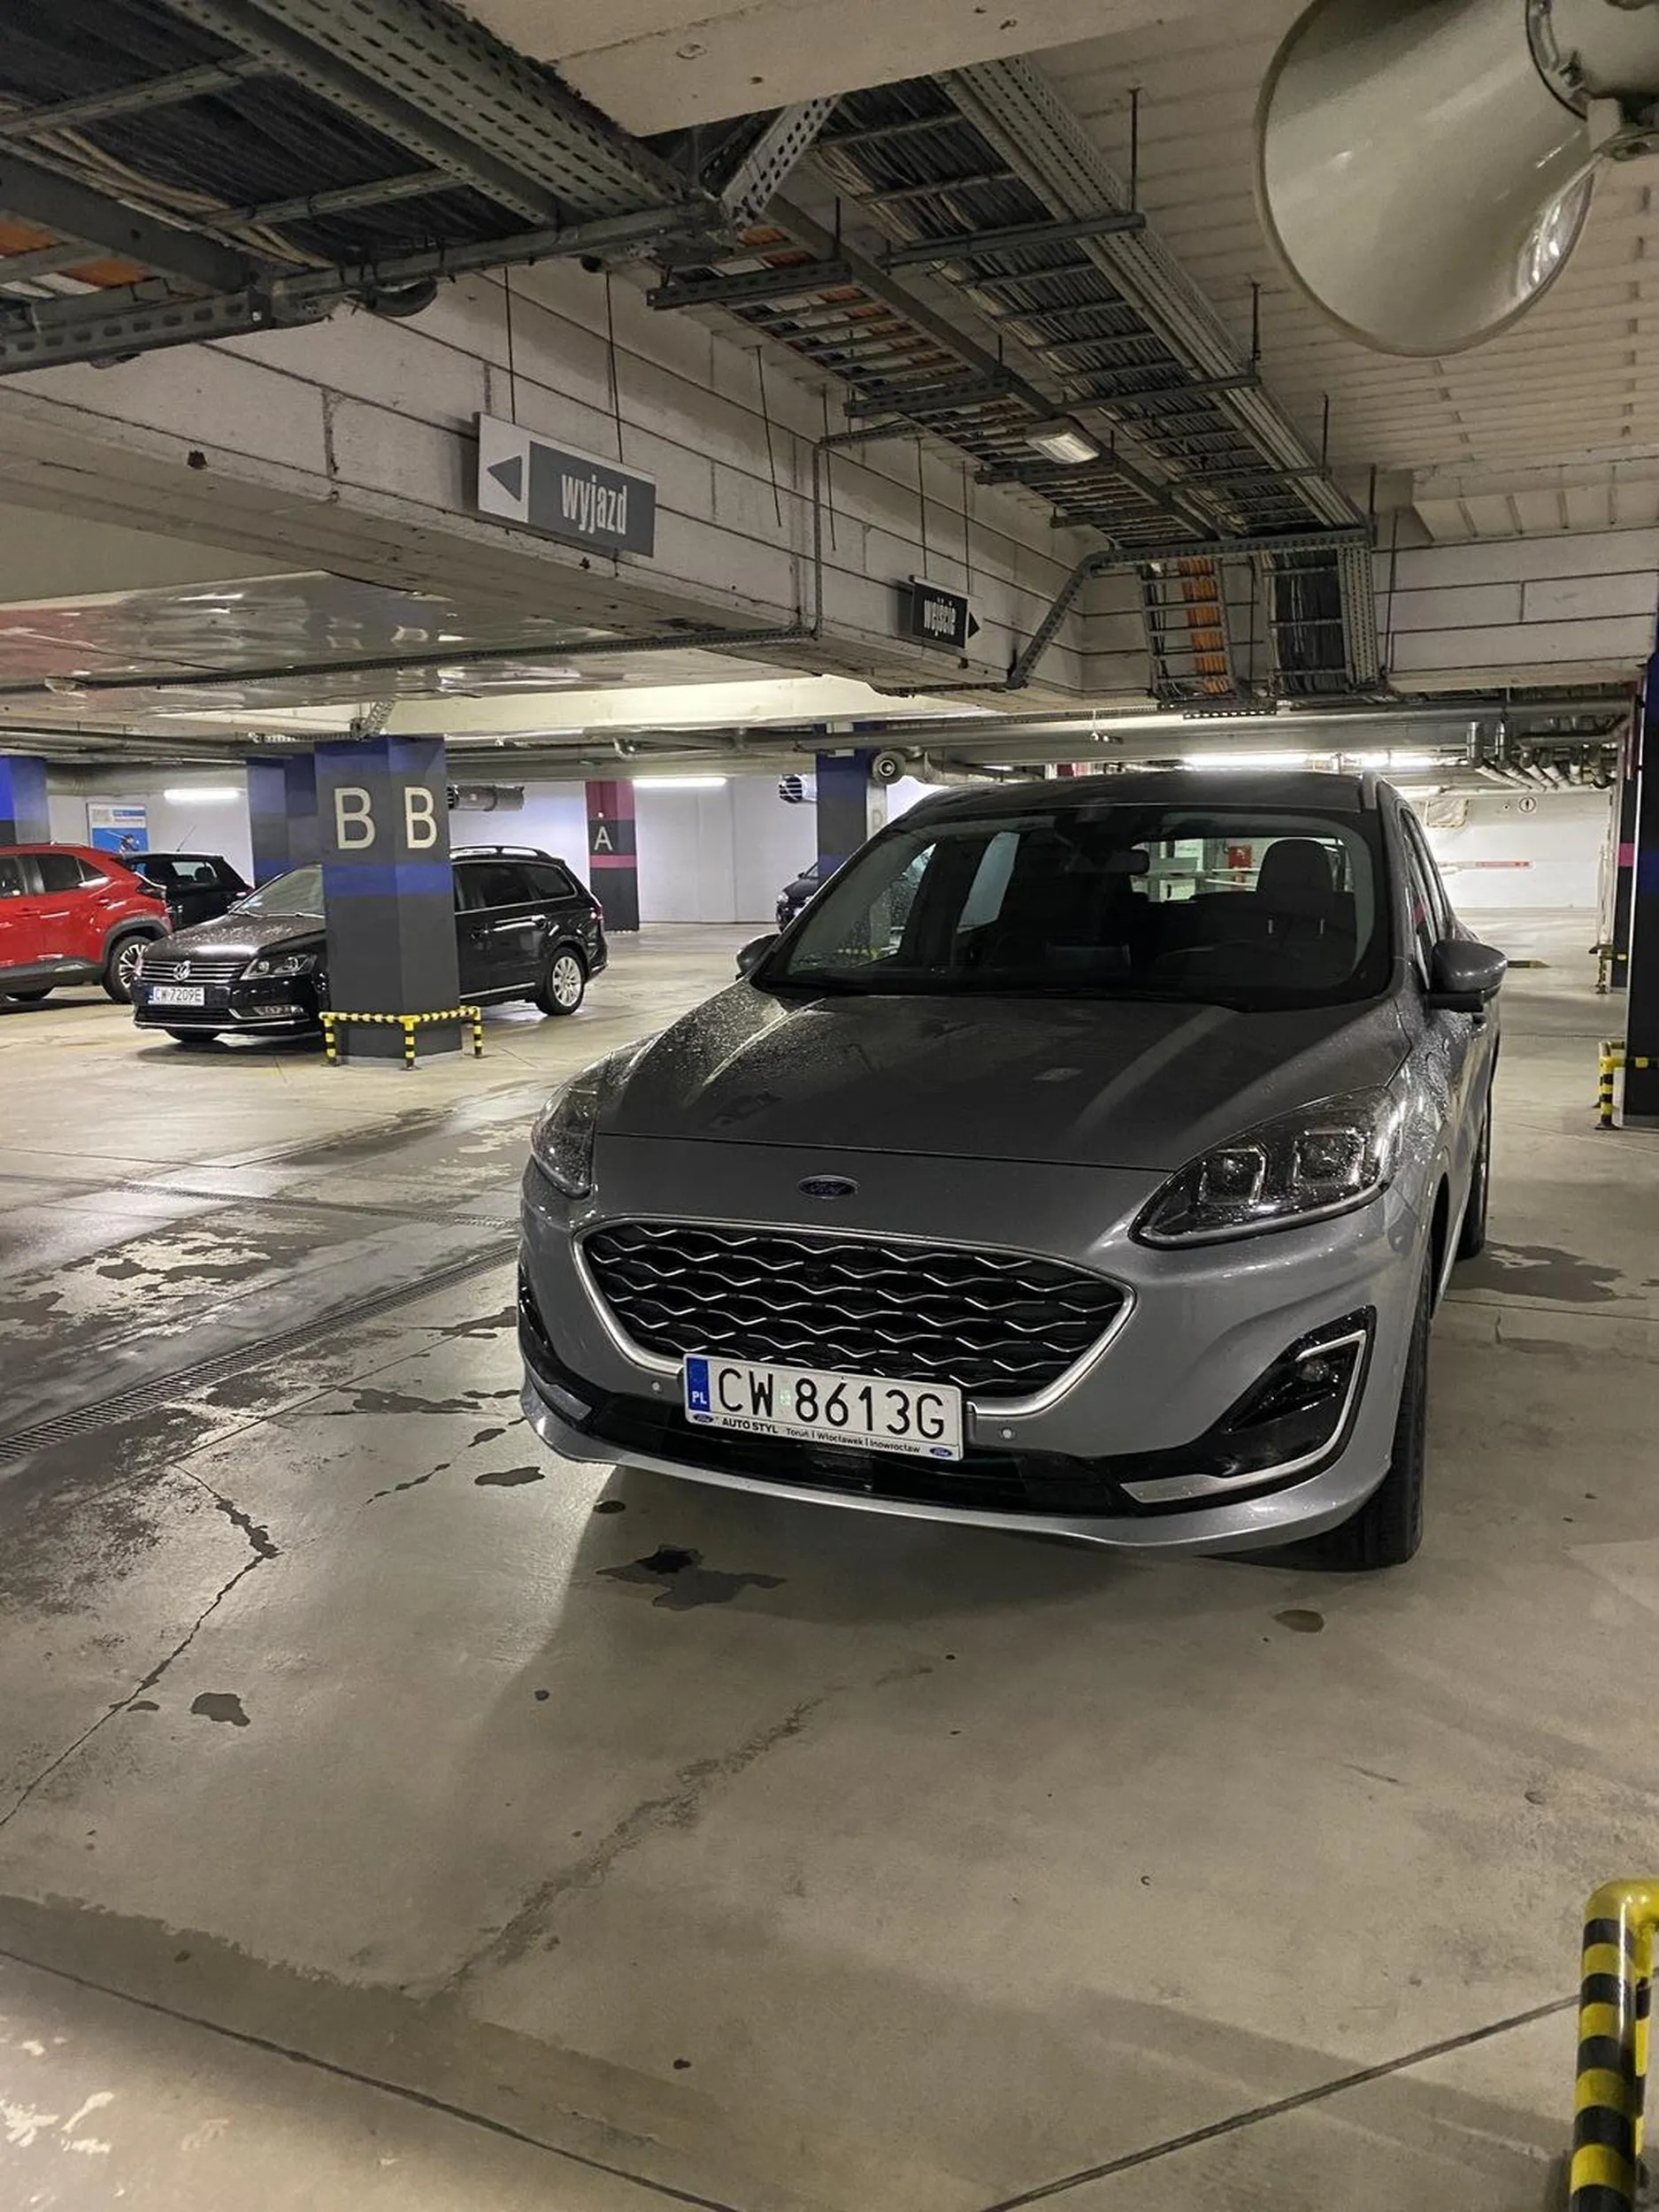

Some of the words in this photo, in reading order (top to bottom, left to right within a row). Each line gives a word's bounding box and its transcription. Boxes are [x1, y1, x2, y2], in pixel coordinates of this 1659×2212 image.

[562, 473, 627, 534] wyjazd
[334, 787, 375, 849] B
[404, 787, 437, 849] B
[594, 826, 613, 851] A
[170, 988, 202, 1002] 7209E
[691, 1391, 708, 1405] PL
[718, 1367, 774, 1417] CW
[795, 1377, 944, 1440] 8613G
[722, 1417, 750, 1430] AUTO
[751, 1422, 780, 1434] STYL
